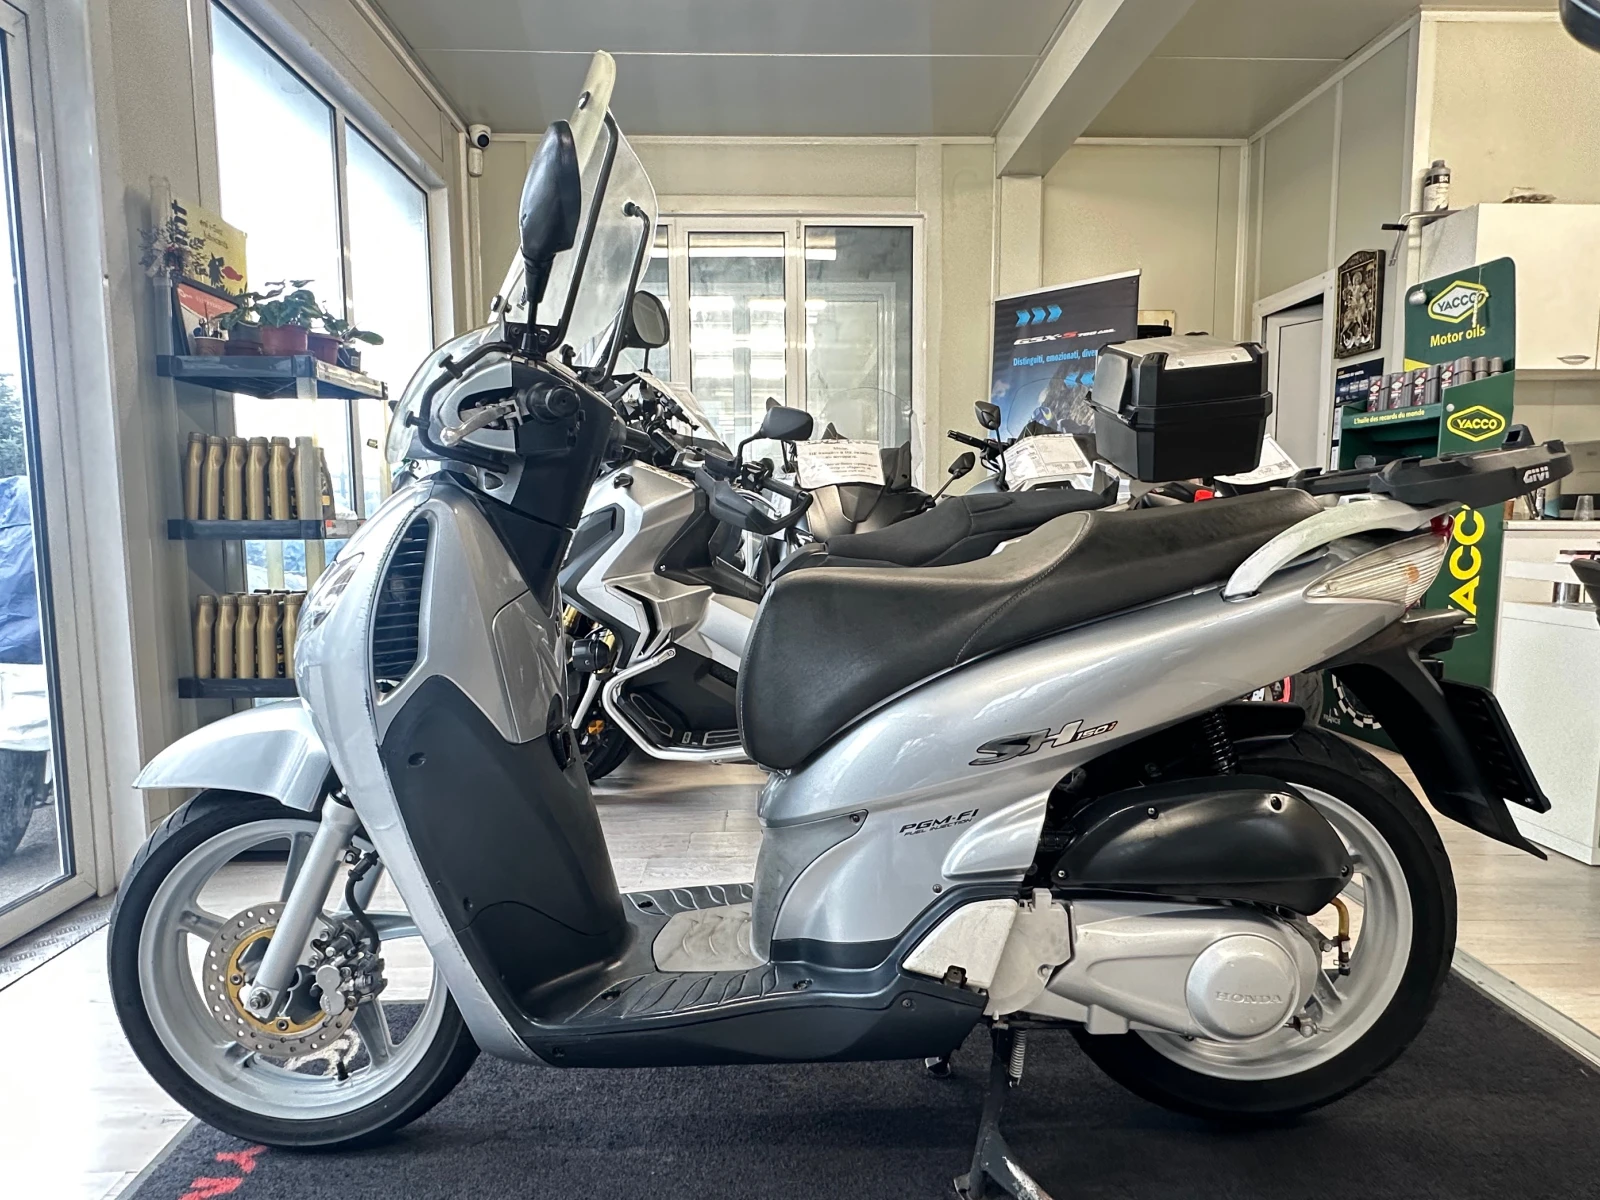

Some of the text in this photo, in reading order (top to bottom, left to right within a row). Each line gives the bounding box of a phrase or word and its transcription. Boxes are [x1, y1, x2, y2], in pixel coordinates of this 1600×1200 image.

[1013, 331, 1079, 345] GSX-S
[1430, 325, 1486, 348] Motor oils
[1013, 354, 1045, 367] Distinguiti,
[1046, 350, 1080, 363] emozionati,
[1370, 415, 1379, 423] des
[1398, 411, 1406, 419] du
[1457, 418, 1498, 430] YACCO
[1523, 465, 1550, 484] GIVI
[904, 818, 973, 837] FUEL INJECTION
[1215, 991, 1283, 1005] HONDA
